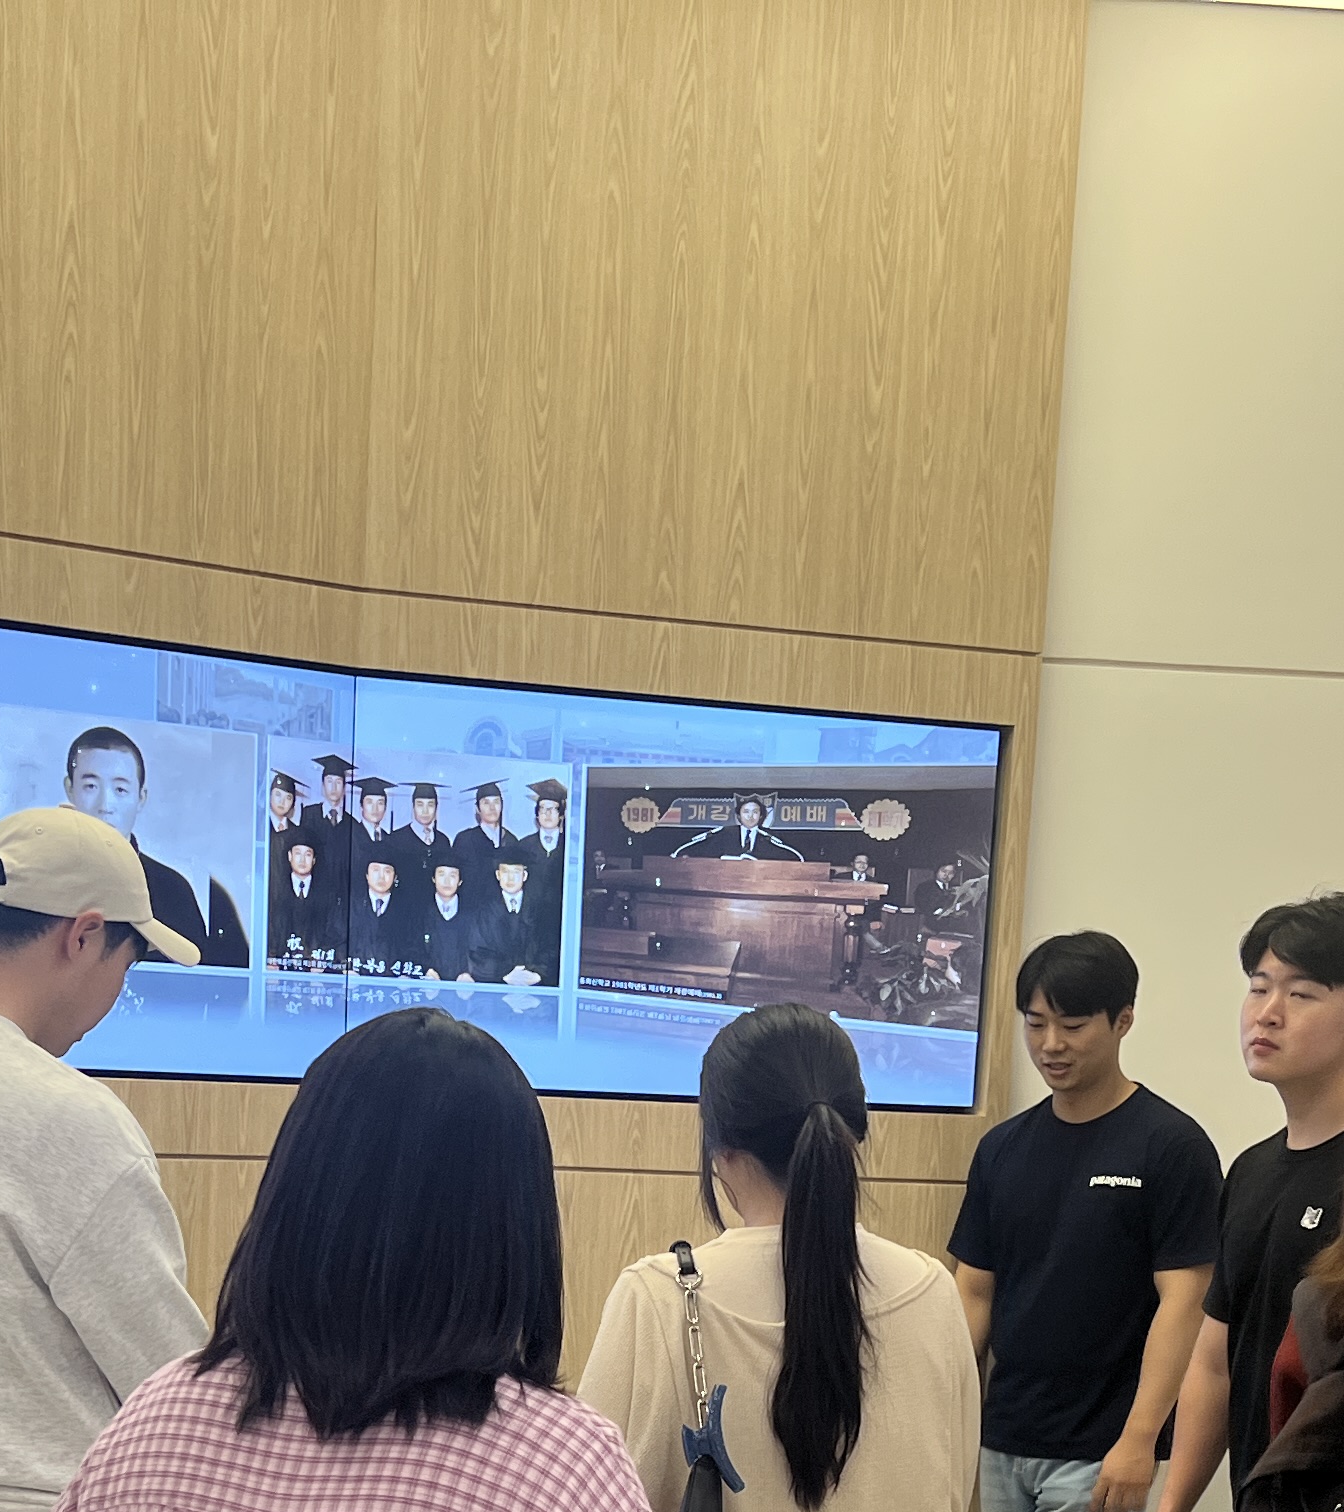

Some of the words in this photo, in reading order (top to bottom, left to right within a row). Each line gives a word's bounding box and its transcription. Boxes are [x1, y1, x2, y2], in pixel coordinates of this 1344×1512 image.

[626, 807, 654, 823] 1981
[687, 804, 732, 821] 개강
[780, 806, 827, 822] 예배
[1089, 1175, 1142, 1188] patagonia
